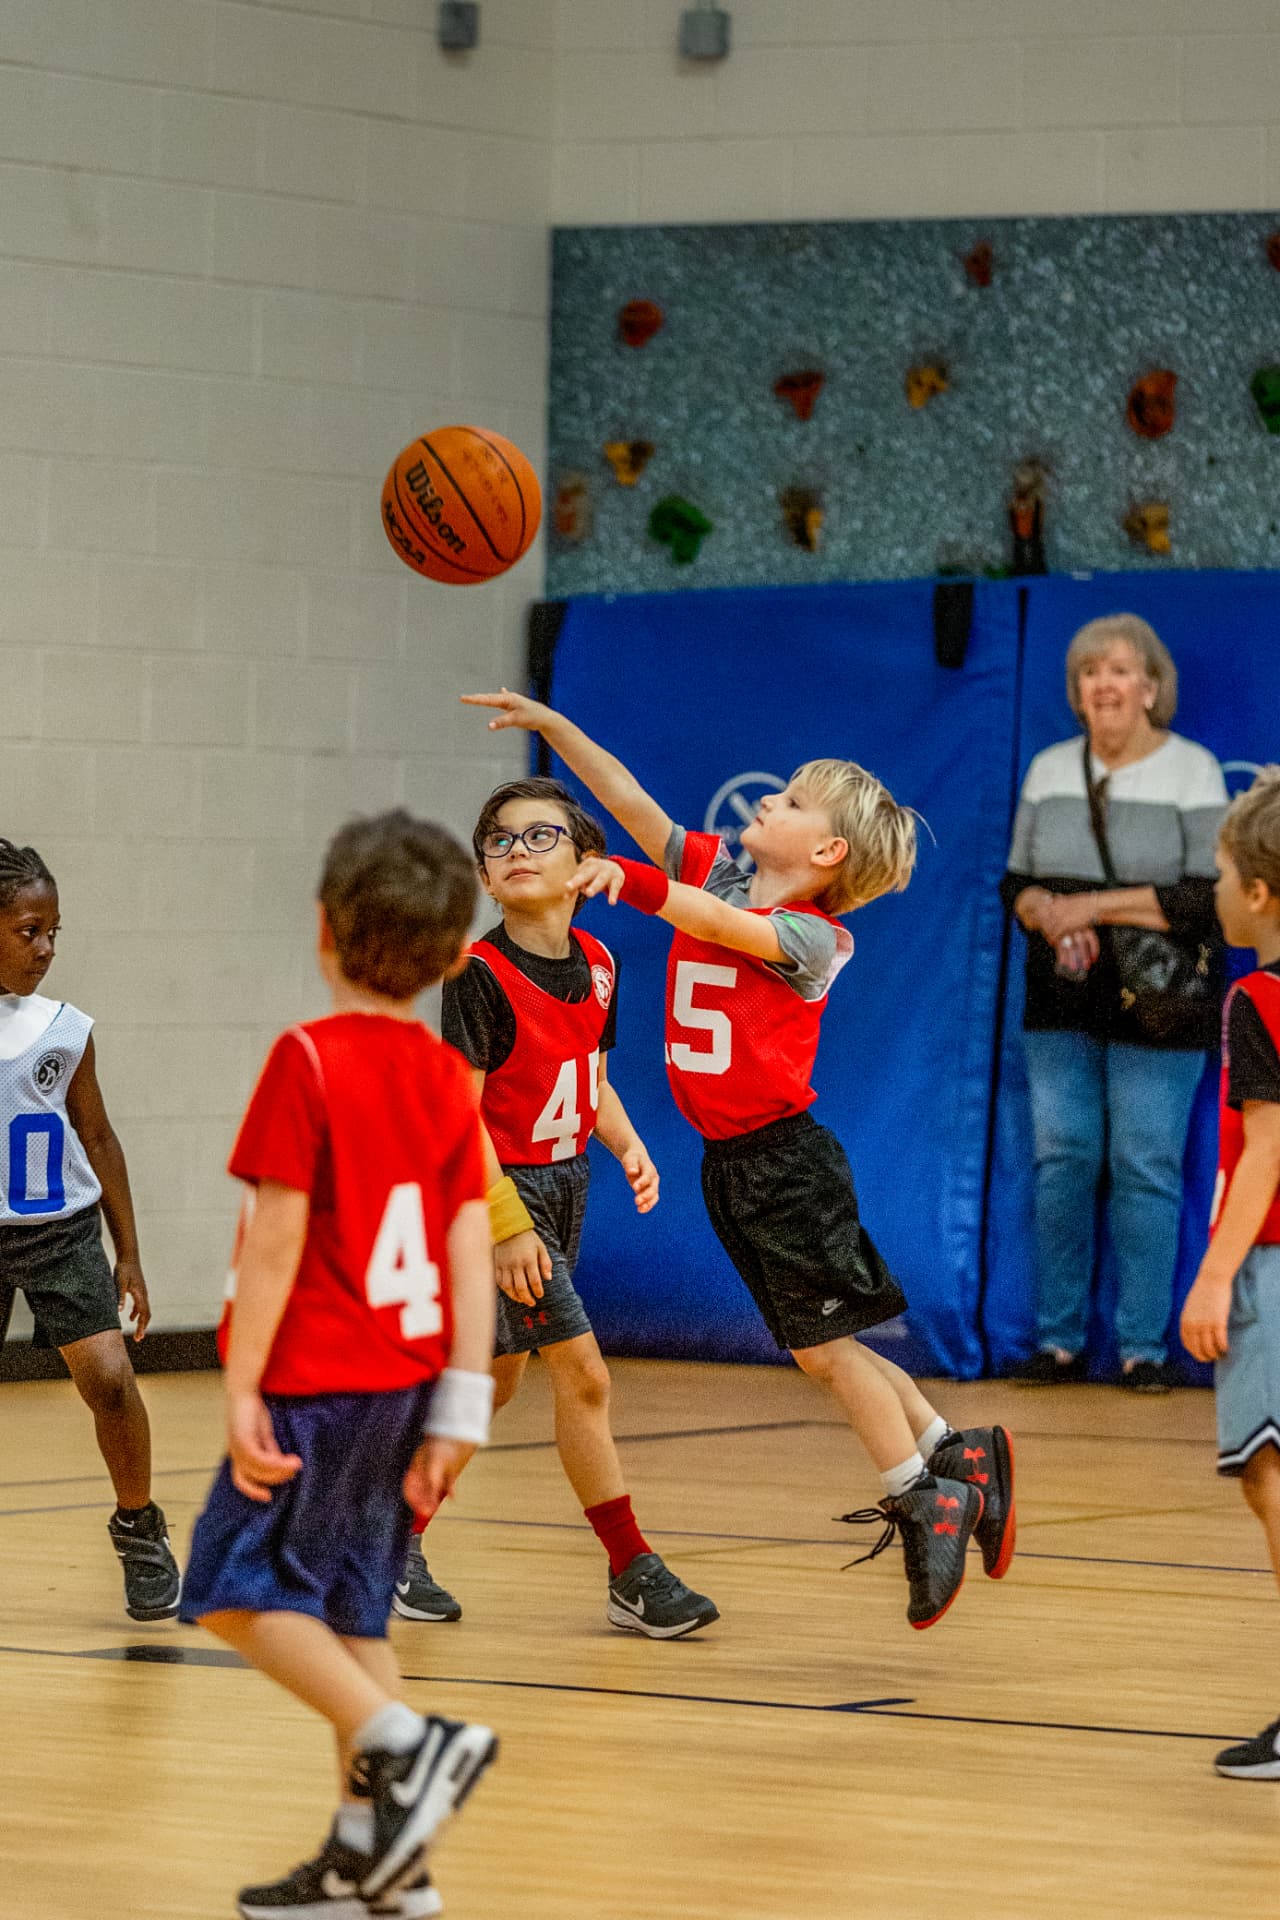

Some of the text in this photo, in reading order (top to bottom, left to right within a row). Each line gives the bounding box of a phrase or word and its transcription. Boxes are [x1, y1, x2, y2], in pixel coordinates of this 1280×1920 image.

[405, 460, 467, 555] Wilson
[665, 960, 738, 1075] 5
[532, 1047, 599, 1162] 4
[8, 1113, 66, 1215] 0
[365, 1182, 443, 1341] 4
